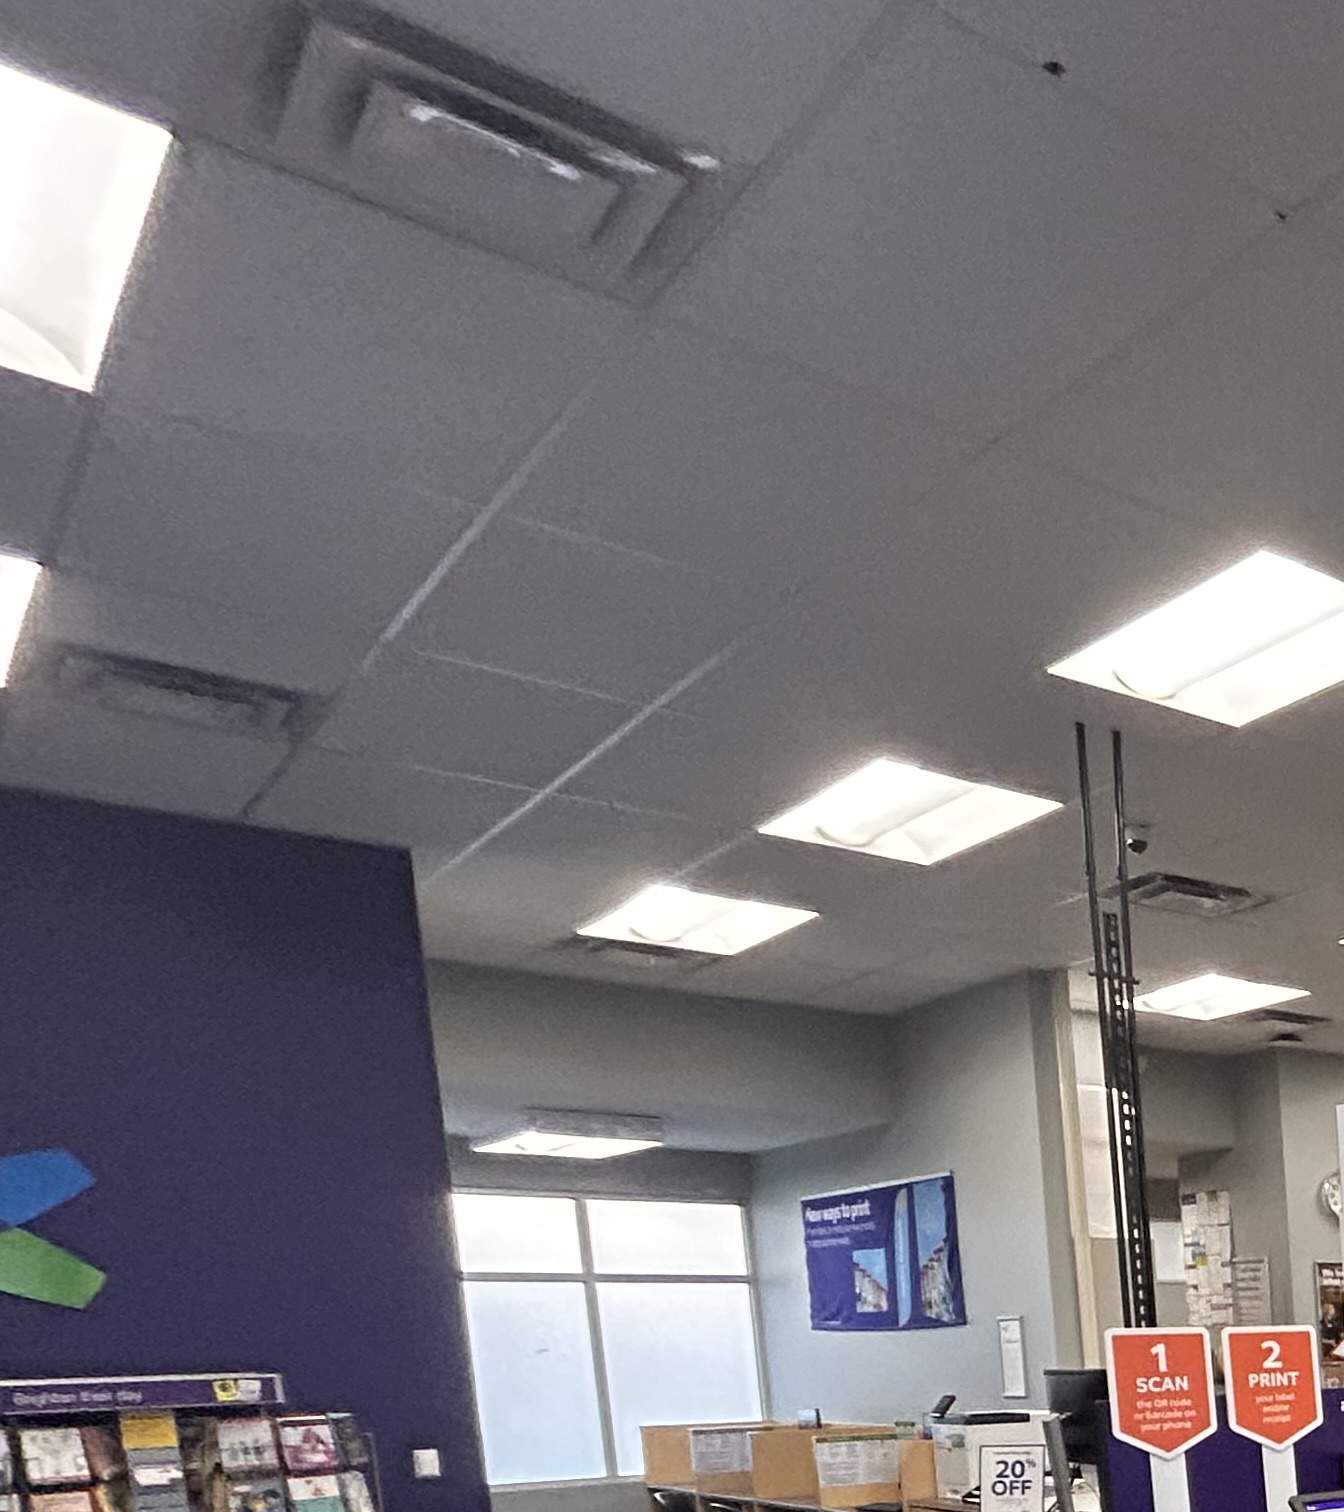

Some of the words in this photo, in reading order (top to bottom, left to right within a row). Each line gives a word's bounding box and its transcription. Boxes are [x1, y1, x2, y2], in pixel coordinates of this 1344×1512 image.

[850, 1199, 871, 1222] print
[1150, 1343, 1168, 1372] 1
[1261, 1340, 1283, 1369] 2
[1135, 1375, 1189, 1393] SCAN
[1248, 1371, 1299, 1388] PRINT
[996, 1458, 1037, 1479] 20%
[991, 1479, 1033, 1496] OFF
